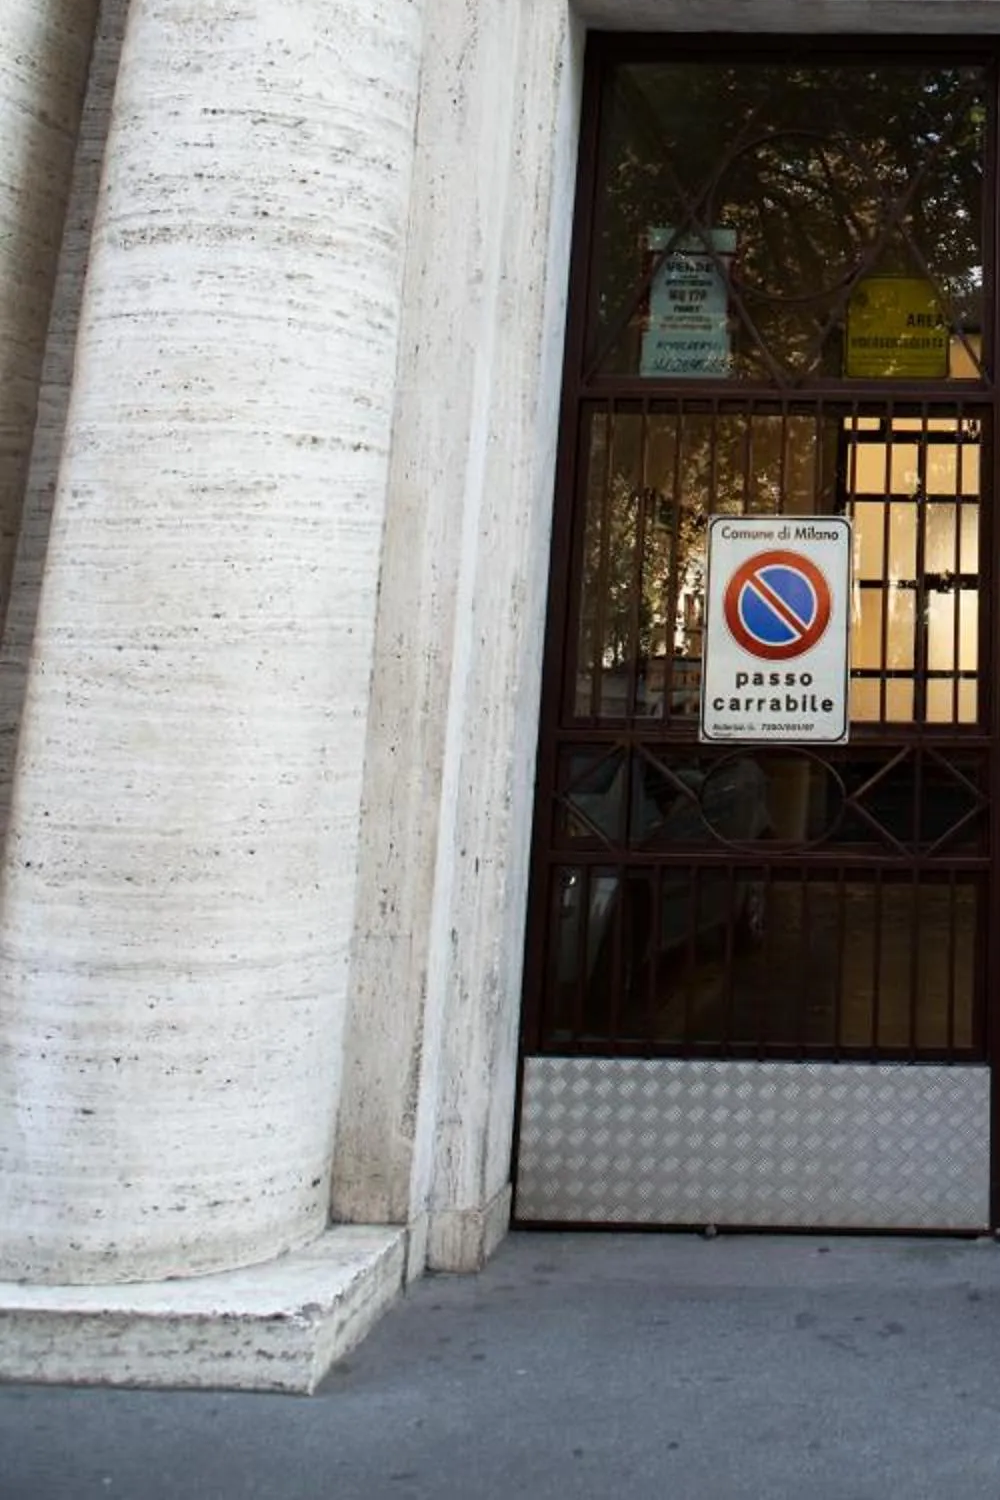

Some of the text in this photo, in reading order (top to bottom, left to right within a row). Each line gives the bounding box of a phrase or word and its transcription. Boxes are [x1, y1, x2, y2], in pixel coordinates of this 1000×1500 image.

[721, 526, 839, 541] Comune di Milano
[735, 672, 813, 689] passo
[712, 694, 834, 712] carrabile
